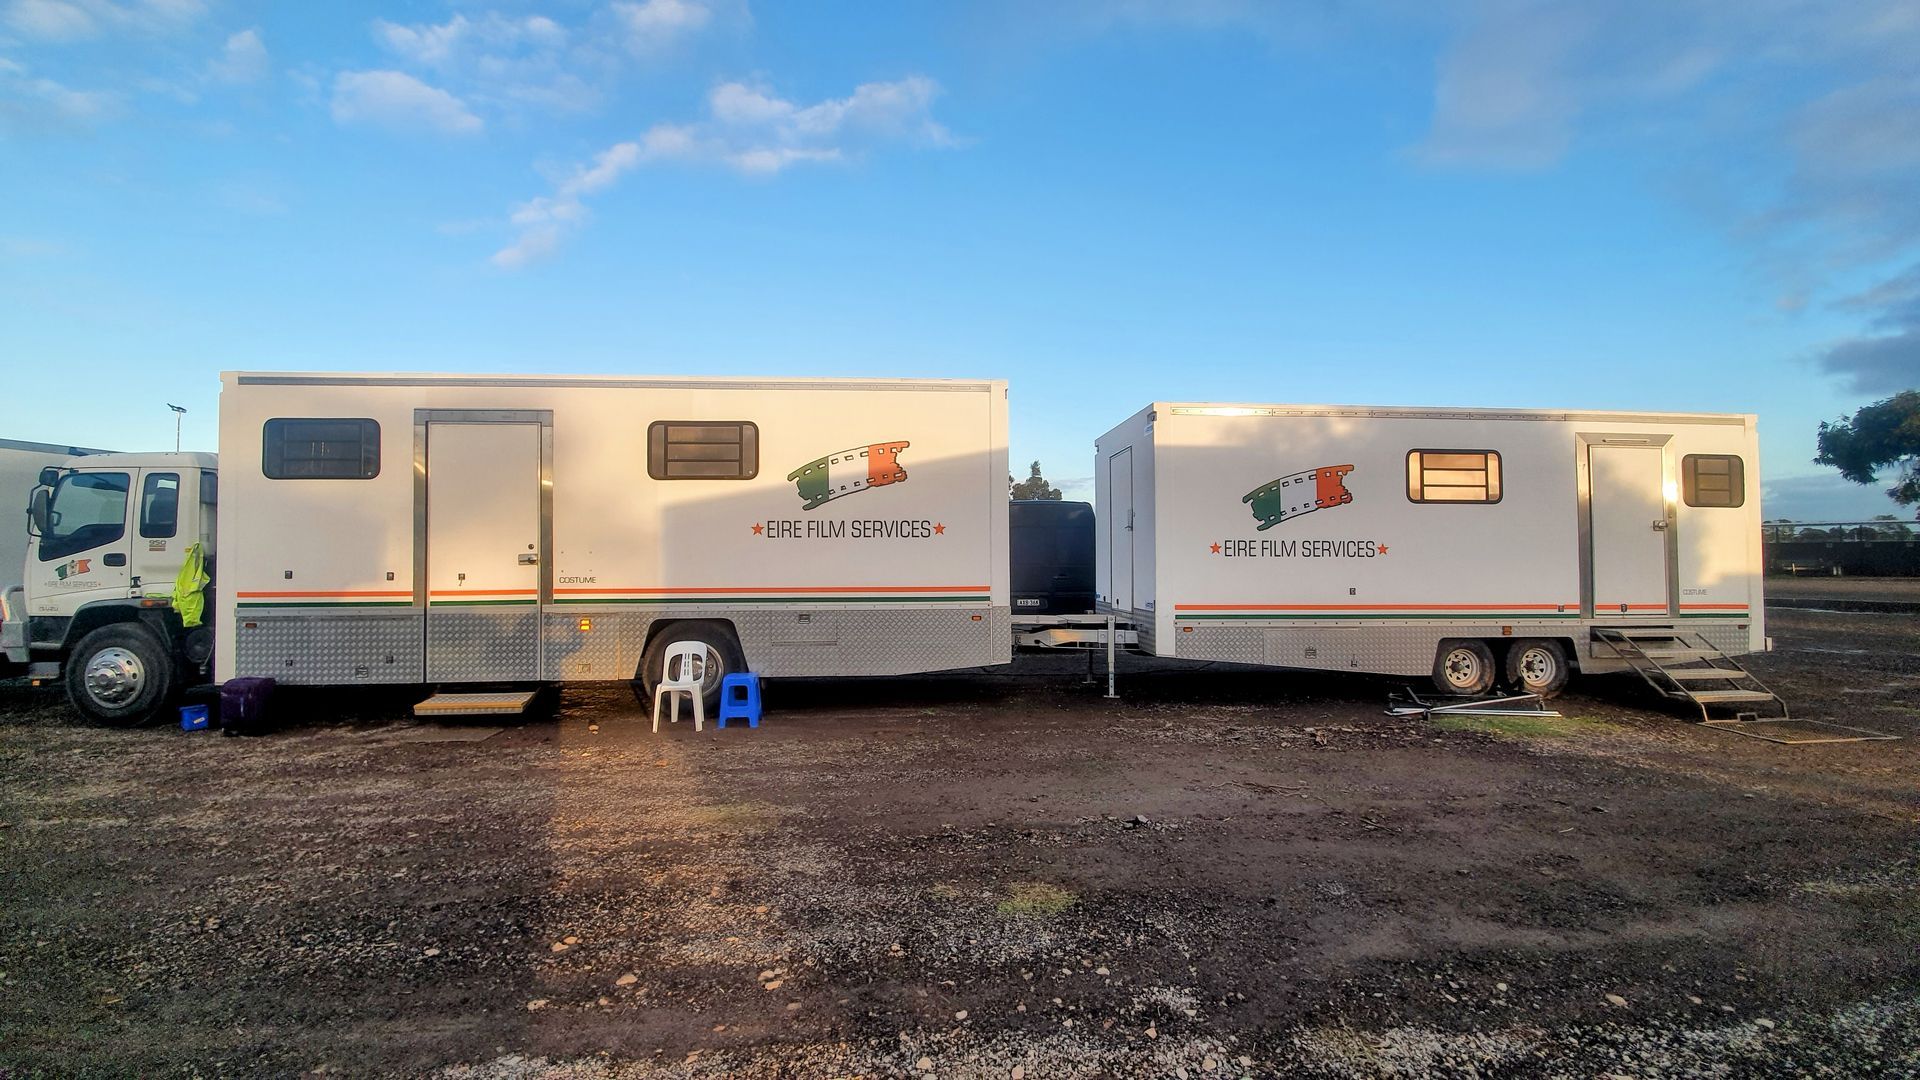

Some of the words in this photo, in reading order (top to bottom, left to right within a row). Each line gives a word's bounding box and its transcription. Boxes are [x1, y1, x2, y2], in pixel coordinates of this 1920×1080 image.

[767, 520, 802, 538] EIRE
[807, 520, 845, 538] FILM
[851, 520, 931, 538] SERVICES
[1224, 540, 1257, 557] EIRE
[1261, 540, 1296, 557] FILM
[1301, 540, 1375, 558] SERVICES
[559, 576, 596, 584] COSTUME
